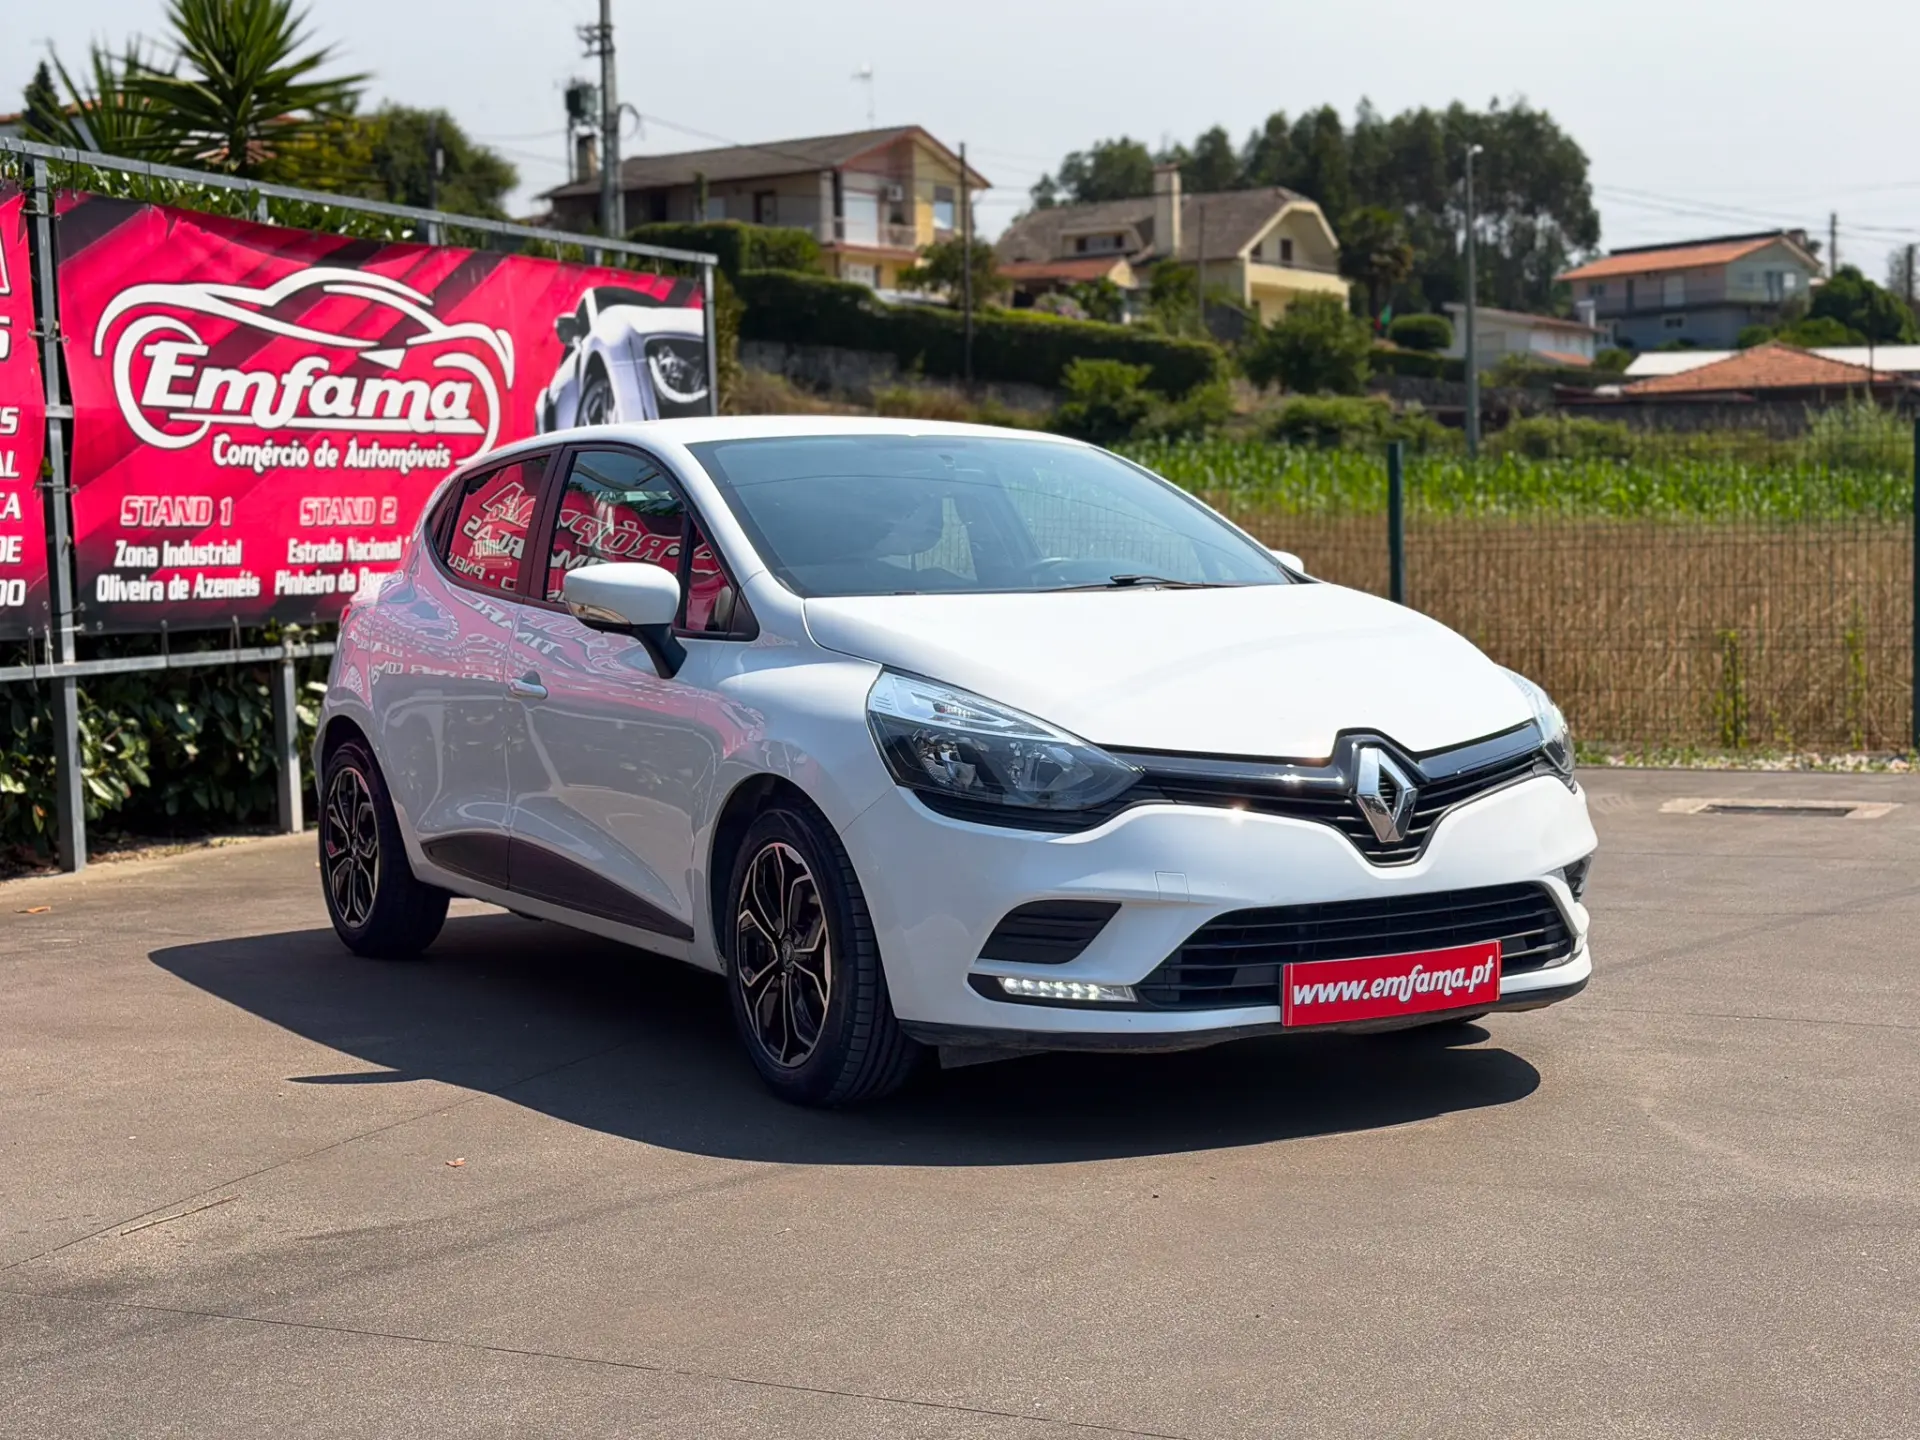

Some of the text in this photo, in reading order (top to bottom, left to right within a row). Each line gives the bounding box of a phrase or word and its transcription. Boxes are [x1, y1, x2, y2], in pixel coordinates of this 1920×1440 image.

[142, 341, 472, 433] Emfama
[212, 433, 450, 474] Comércio de Automóveis
[120, 495, 233, 526] STAND 1
[300, 496, 398, 526] STAND 2
[114, 538, 243, 567] Zona Industrial
[287, 537, 343, 563] Estrada
[346, 535, 402, 562] Nacional
[96, 570, 261, 602] Oliveira de Azeméis
[274, 569, 335, 595] Pinheiro
[338, 568, 356, 593] da
[1293, 955, 1495, 1005] www.emfama.pt
